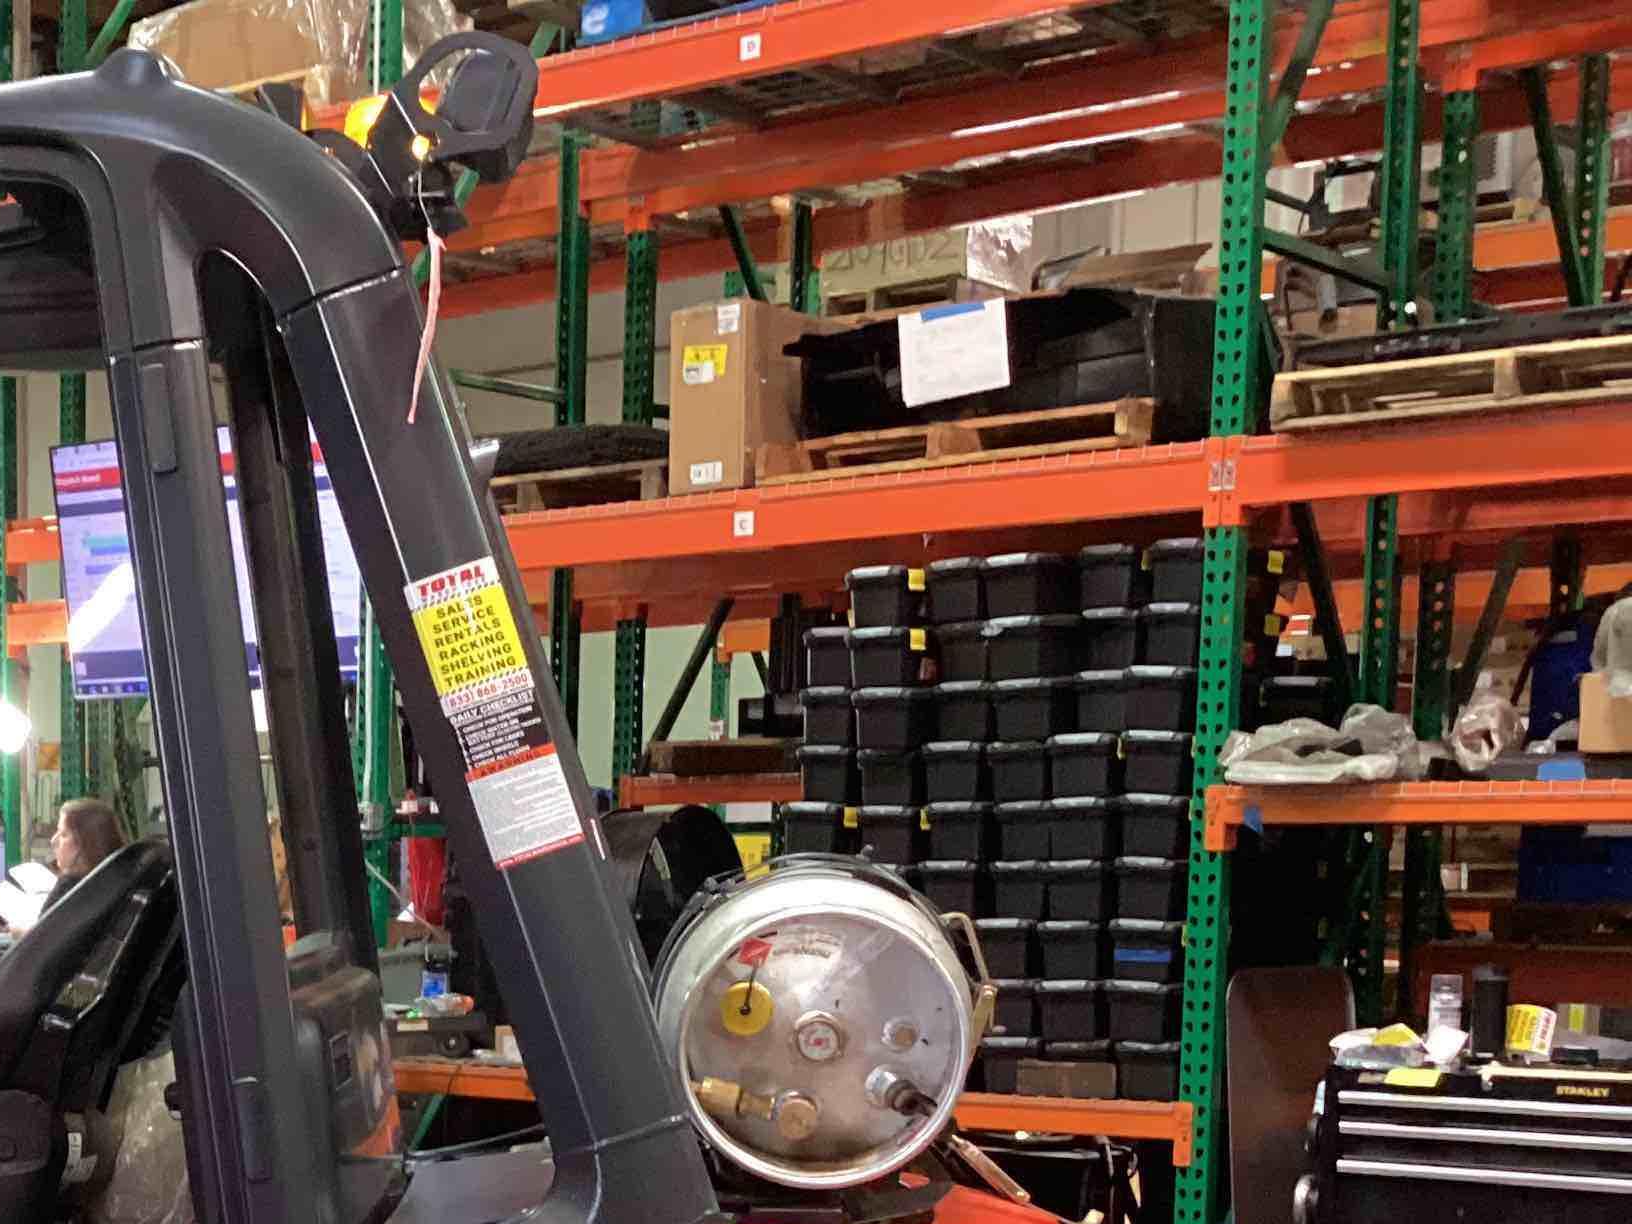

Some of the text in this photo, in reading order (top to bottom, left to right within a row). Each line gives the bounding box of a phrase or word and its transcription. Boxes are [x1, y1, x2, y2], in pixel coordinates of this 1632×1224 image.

[416, 565, 486, 598] TOTAL
[431, 605, 496, 635] SERVICE
[436, 594, 483, 618] SALES
[434, 617, 502, 649] RENTALS
[438, 631, 506, 661] RACKING
[440, 642, 512, 675] SHELVING
[445, 655, 517, 688] TRAINING
[1555, 1085, 1610, 1098] STANLEY
